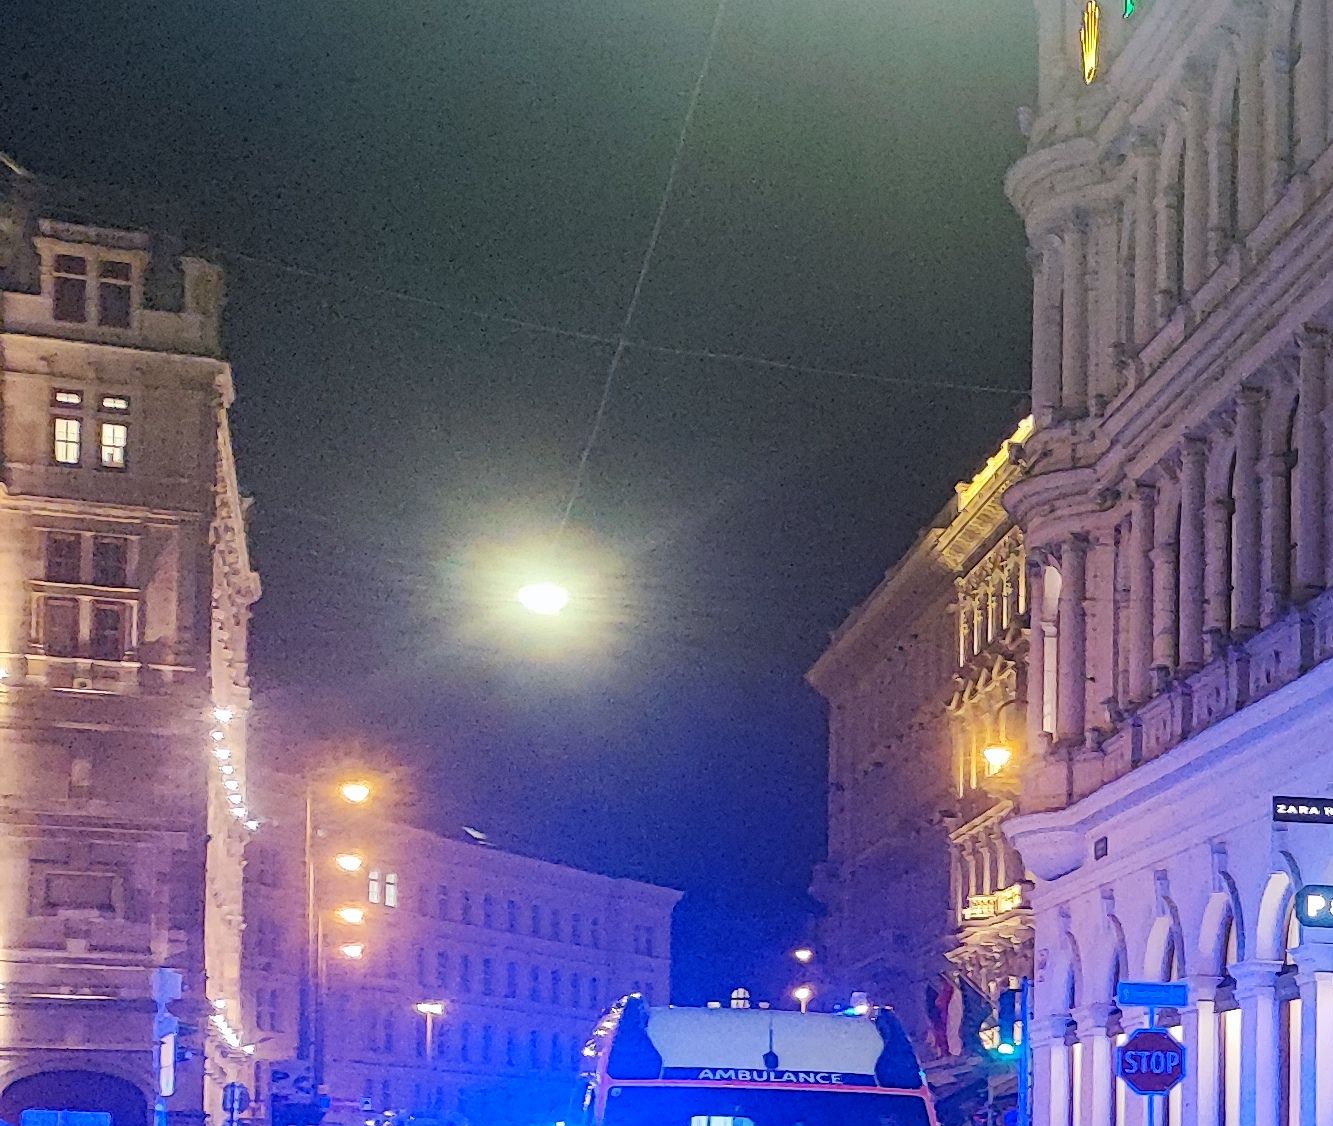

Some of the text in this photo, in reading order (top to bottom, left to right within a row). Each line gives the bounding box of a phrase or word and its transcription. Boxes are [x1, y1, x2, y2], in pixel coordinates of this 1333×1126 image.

[1276, 804, 1320, 815] ZARA
[1124, 1051, 1180, 1074] STOP
[697, 1068, 844, 1084] AMBULANCE
